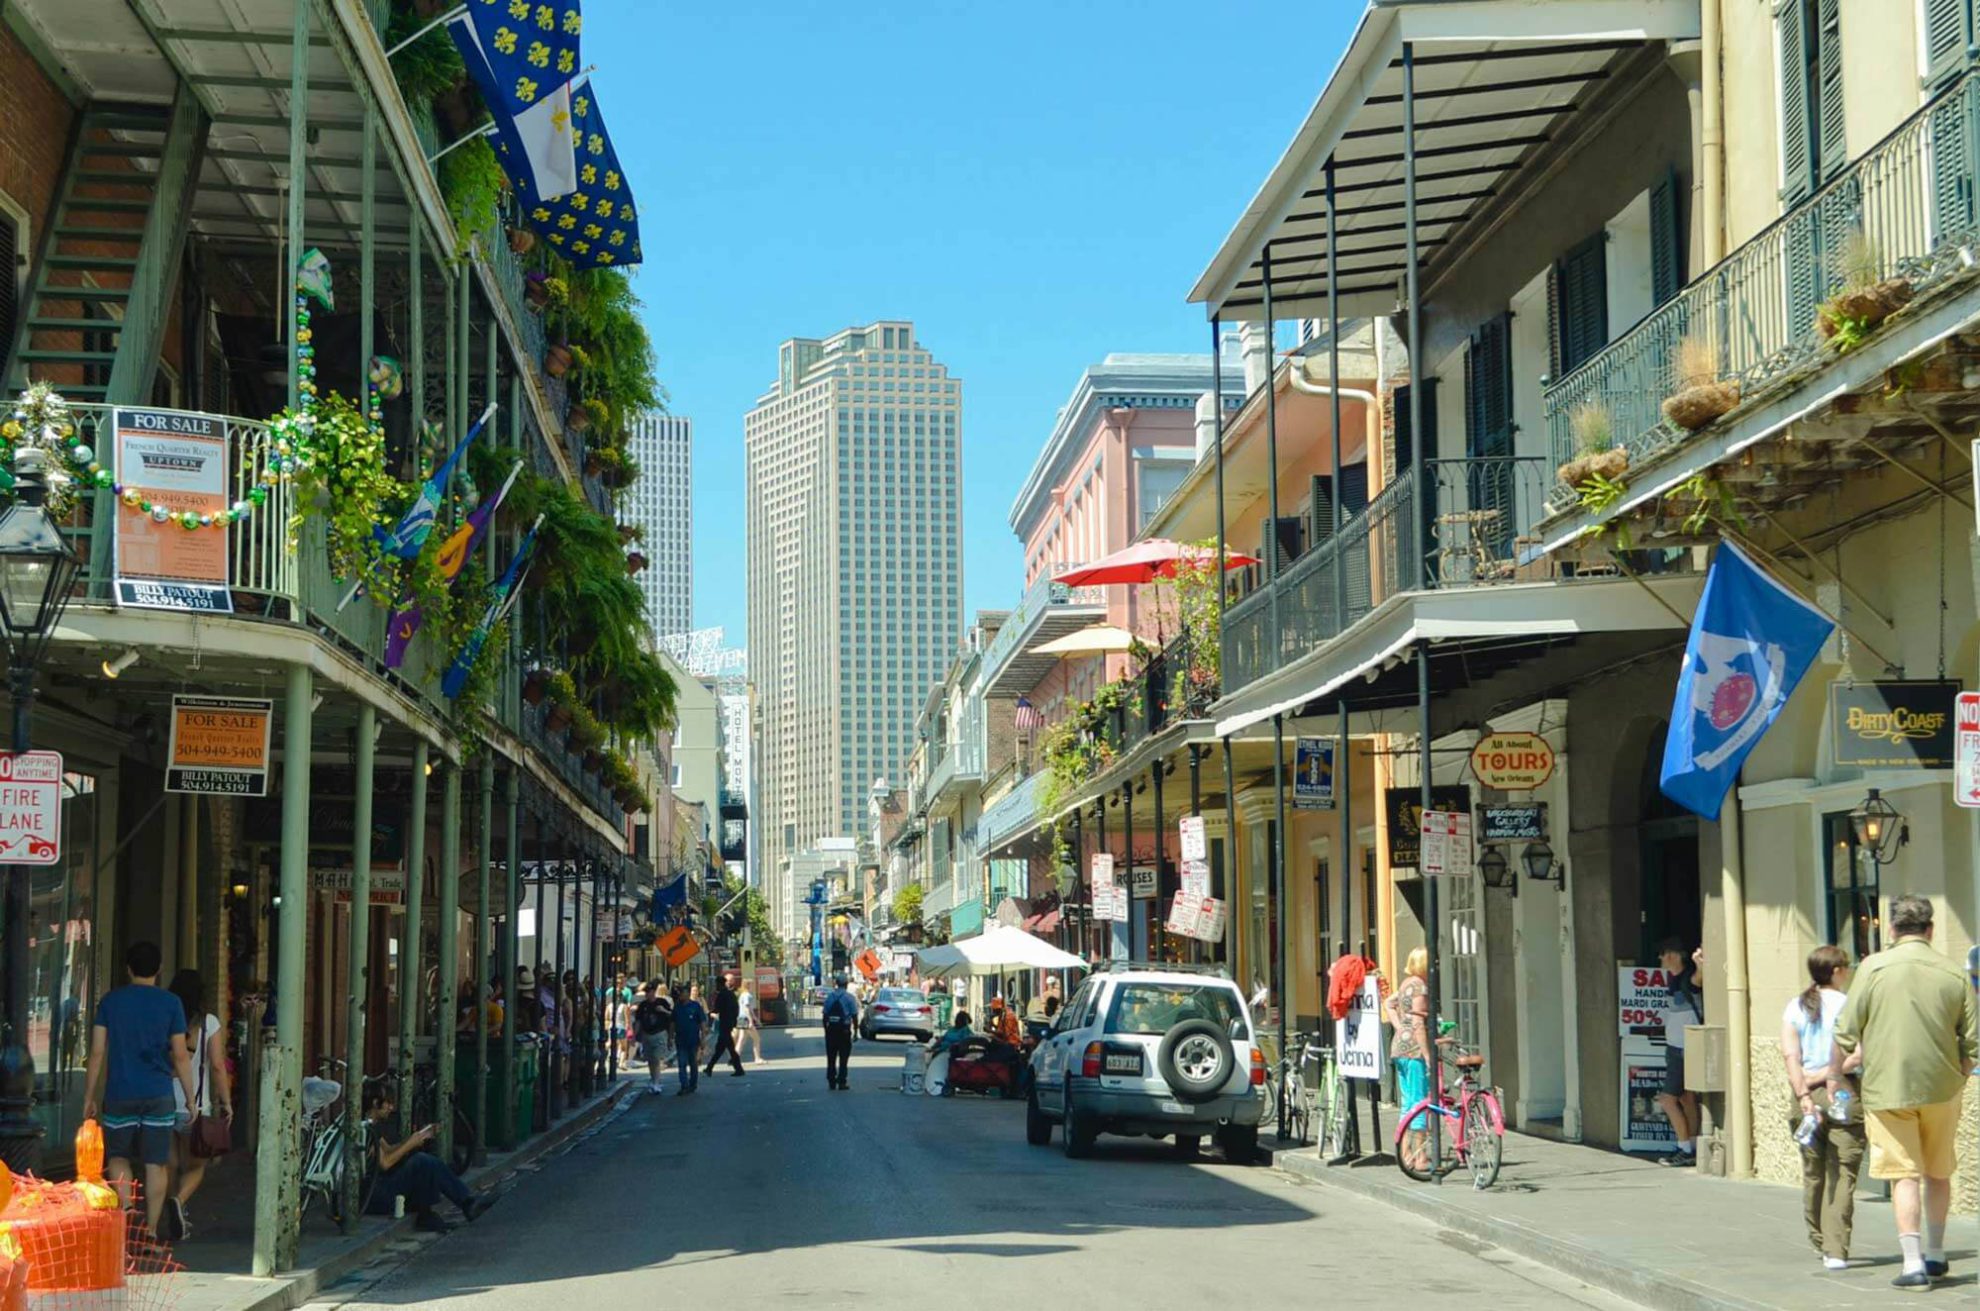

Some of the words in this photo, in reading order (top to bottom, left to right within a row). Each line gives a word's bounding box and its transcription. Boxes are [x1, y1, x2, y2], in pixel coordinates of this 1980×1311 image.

[134, 414, 167, 429] FOR
[172, 417, 212, 434] SALE
[149, 456, 197, 467] UPTOWN
[133, 584, 165, 594] BILLY
[167, 586, 214, 599] PATOUT
[135, 594, 215, 608] 504.914.5191
[185, 714, 217, 727] FOR
[221, 716, 258, 729] SALE
[733, 710, 743, 753] HOTEL
[177, 744, 262, 759] 504-949-5400
[1506, 740, 1533, 749] About
[1478, 752, 1548, 770] TOURS
[16, 768, 55, 778] ANYTIME
[181, 771, 208, 781] BILLY
[211, 773, 253, 784] PATOUT
[1508, 774, 1535, 782] Orleans
[180, 782, 250, 793] 504.914.5191
[3, 788, 41, 806] FIRE
[0, 813, 43, 830] LANE
[1116, 872, 1153, 885] RUSES
[1633, 969, 1674, 988] SA
[1621, 999, 1648, 1007] MARDI
[1650, 1000, 1669, 1008] GRA
[1621, 1009, 1663, 1025] 50%
[1339, 1043, 1375, 1067] Jenna
